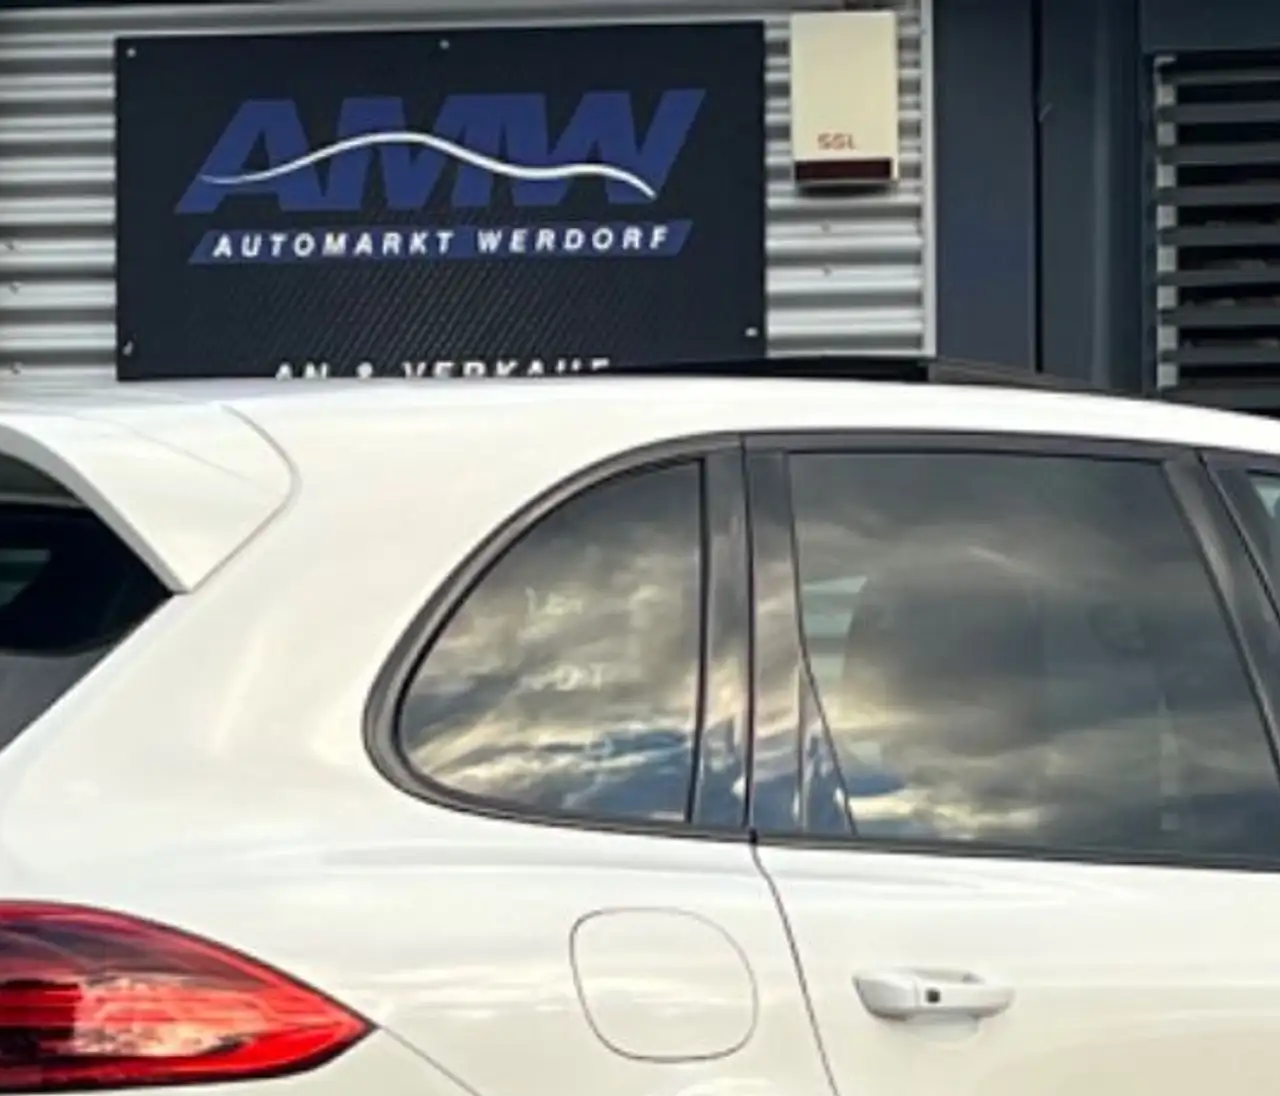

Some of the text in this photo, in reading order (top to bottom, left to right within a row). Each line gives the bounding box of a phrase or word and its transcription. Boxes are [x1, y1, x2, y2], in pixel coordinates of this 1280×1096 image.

[173, 87, 708, 214] AMW
[212, 225, 670, 258] AUTOMARKT WERDORF
